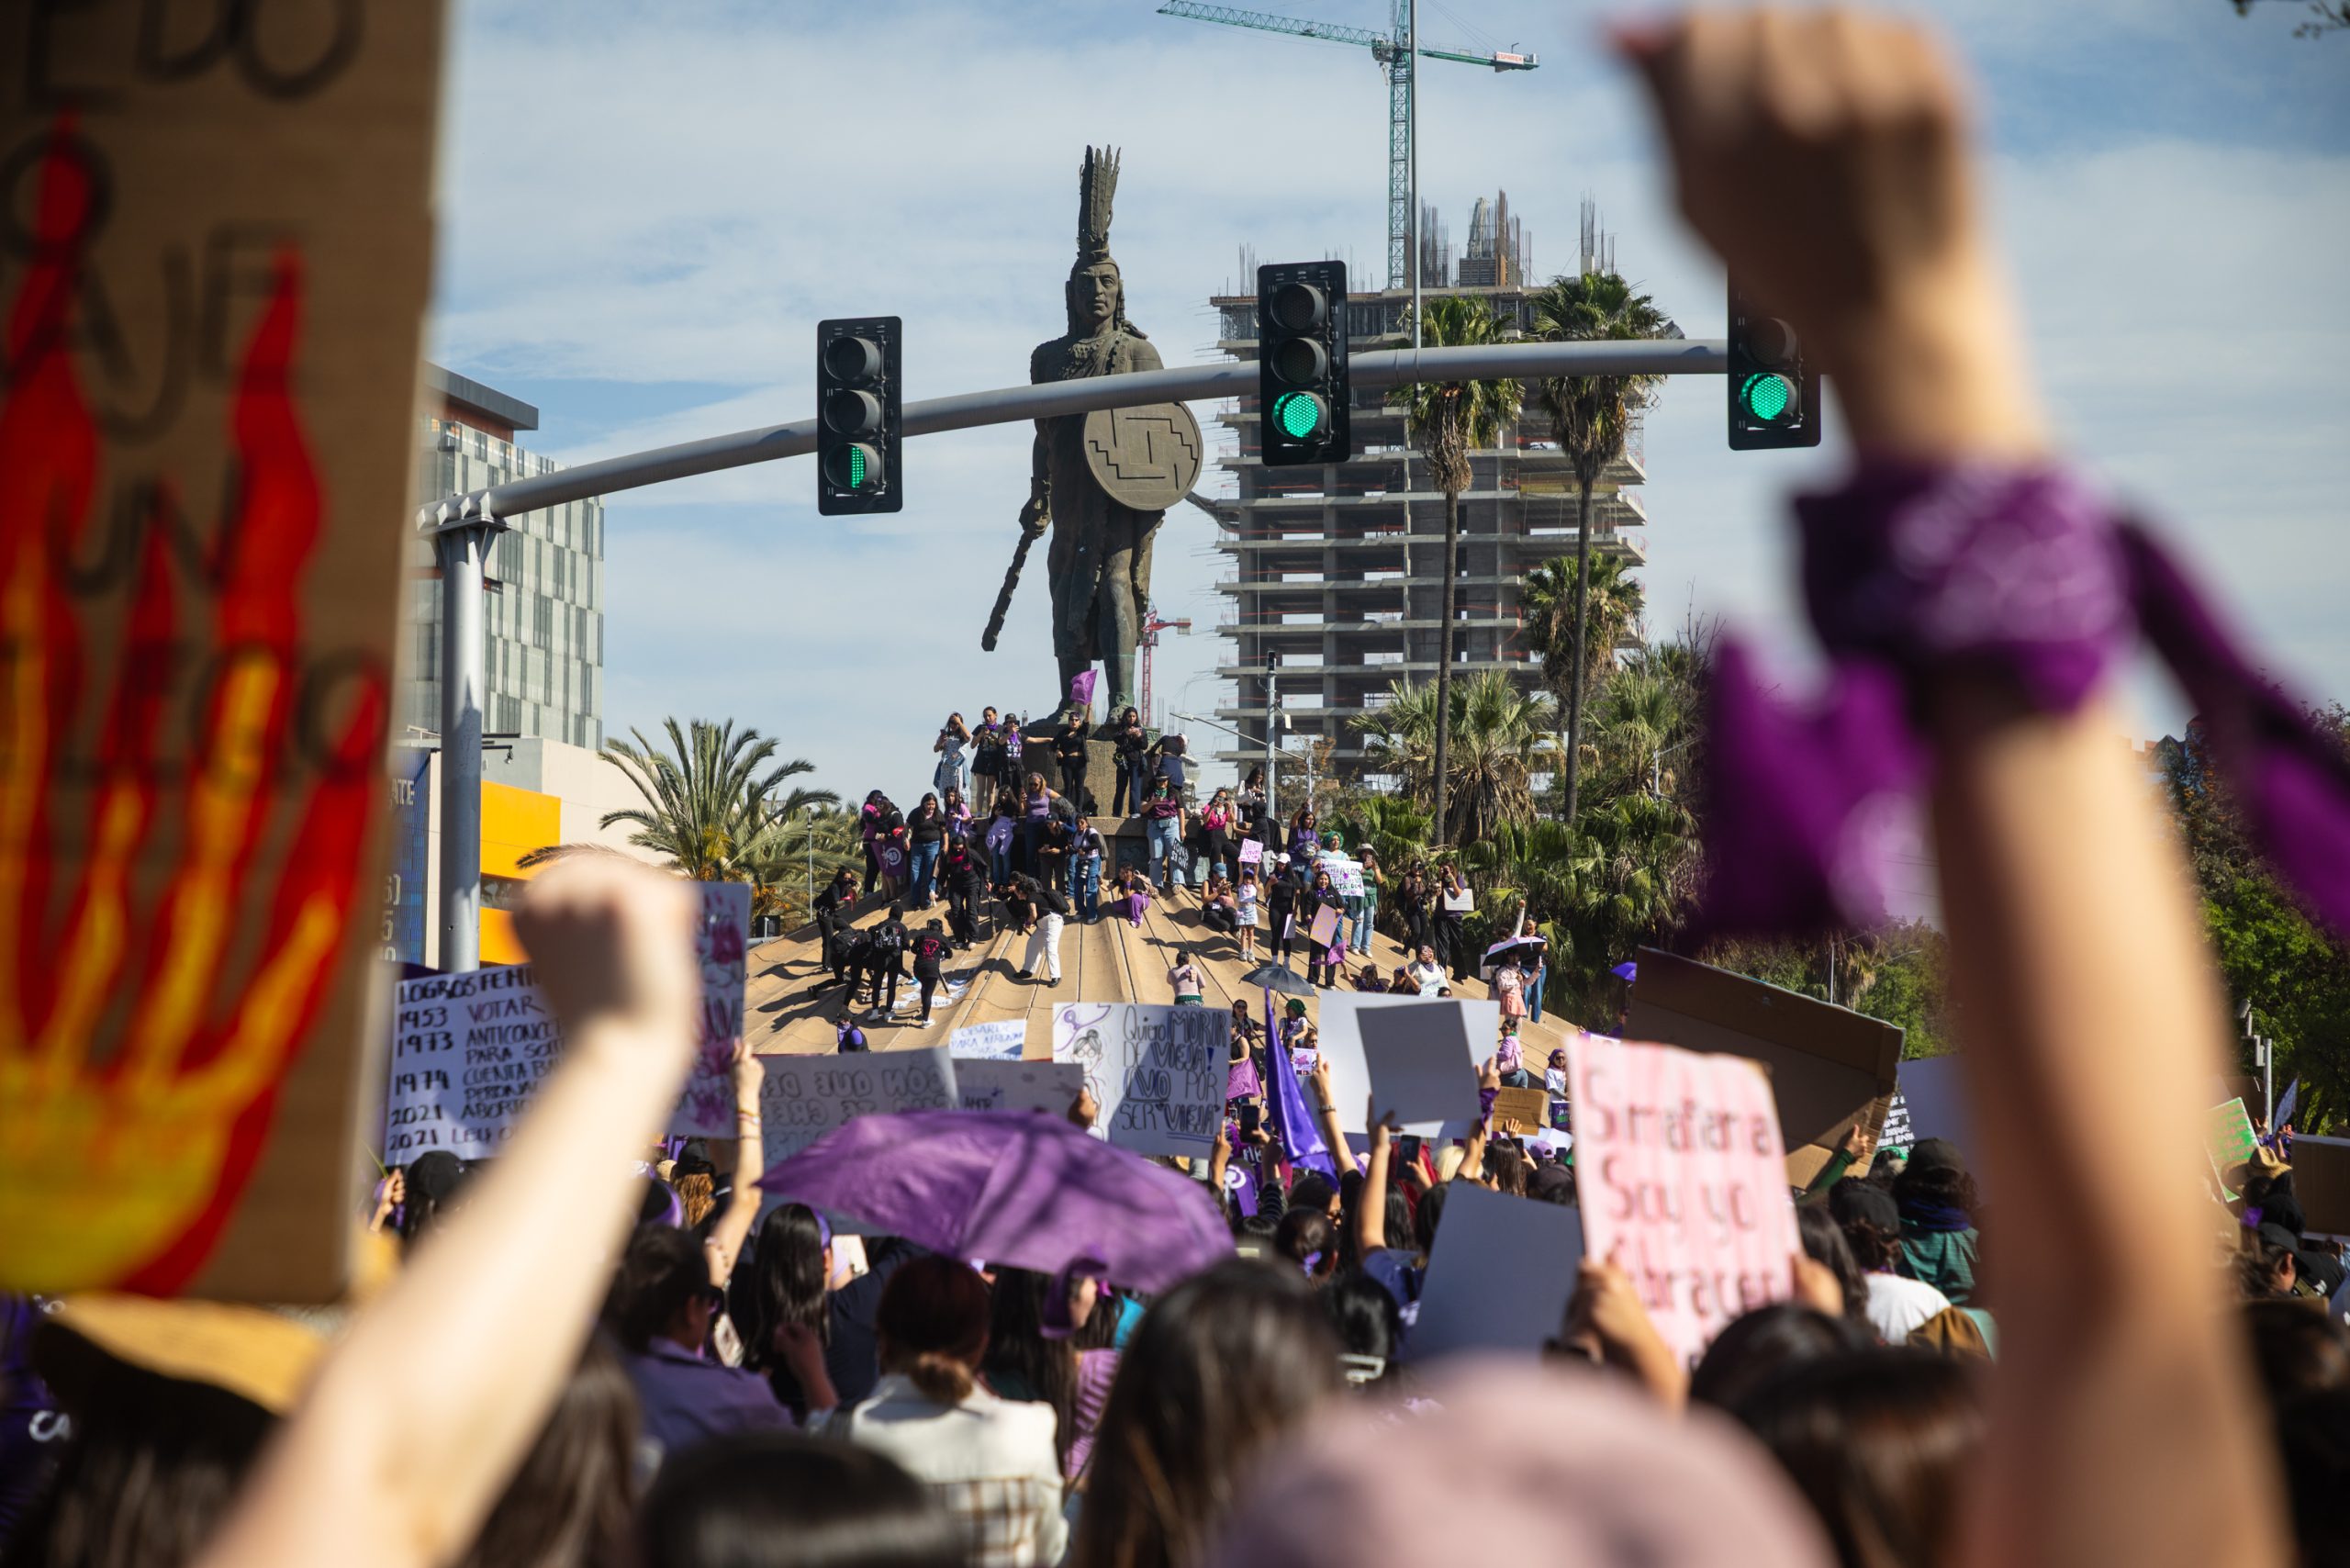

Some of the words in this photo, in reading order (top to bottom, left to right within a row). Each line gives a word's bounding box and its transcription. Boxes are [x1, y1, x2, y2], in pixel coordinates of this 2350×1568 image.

[398, 1006, 448, 1034] 1953
[467, 995, 546, 1025] VOTAR
[1168, 1010, 1227, 1048] MORIR
[465, 1045, 513, 1066] PARA
[1123, 1040, 1144, 1069] DE
[1123, 1066, 1173, 1102] NO
[1184, 1070, 1219, 1107] POR
[390, 1103, 442, 1127] 2021
